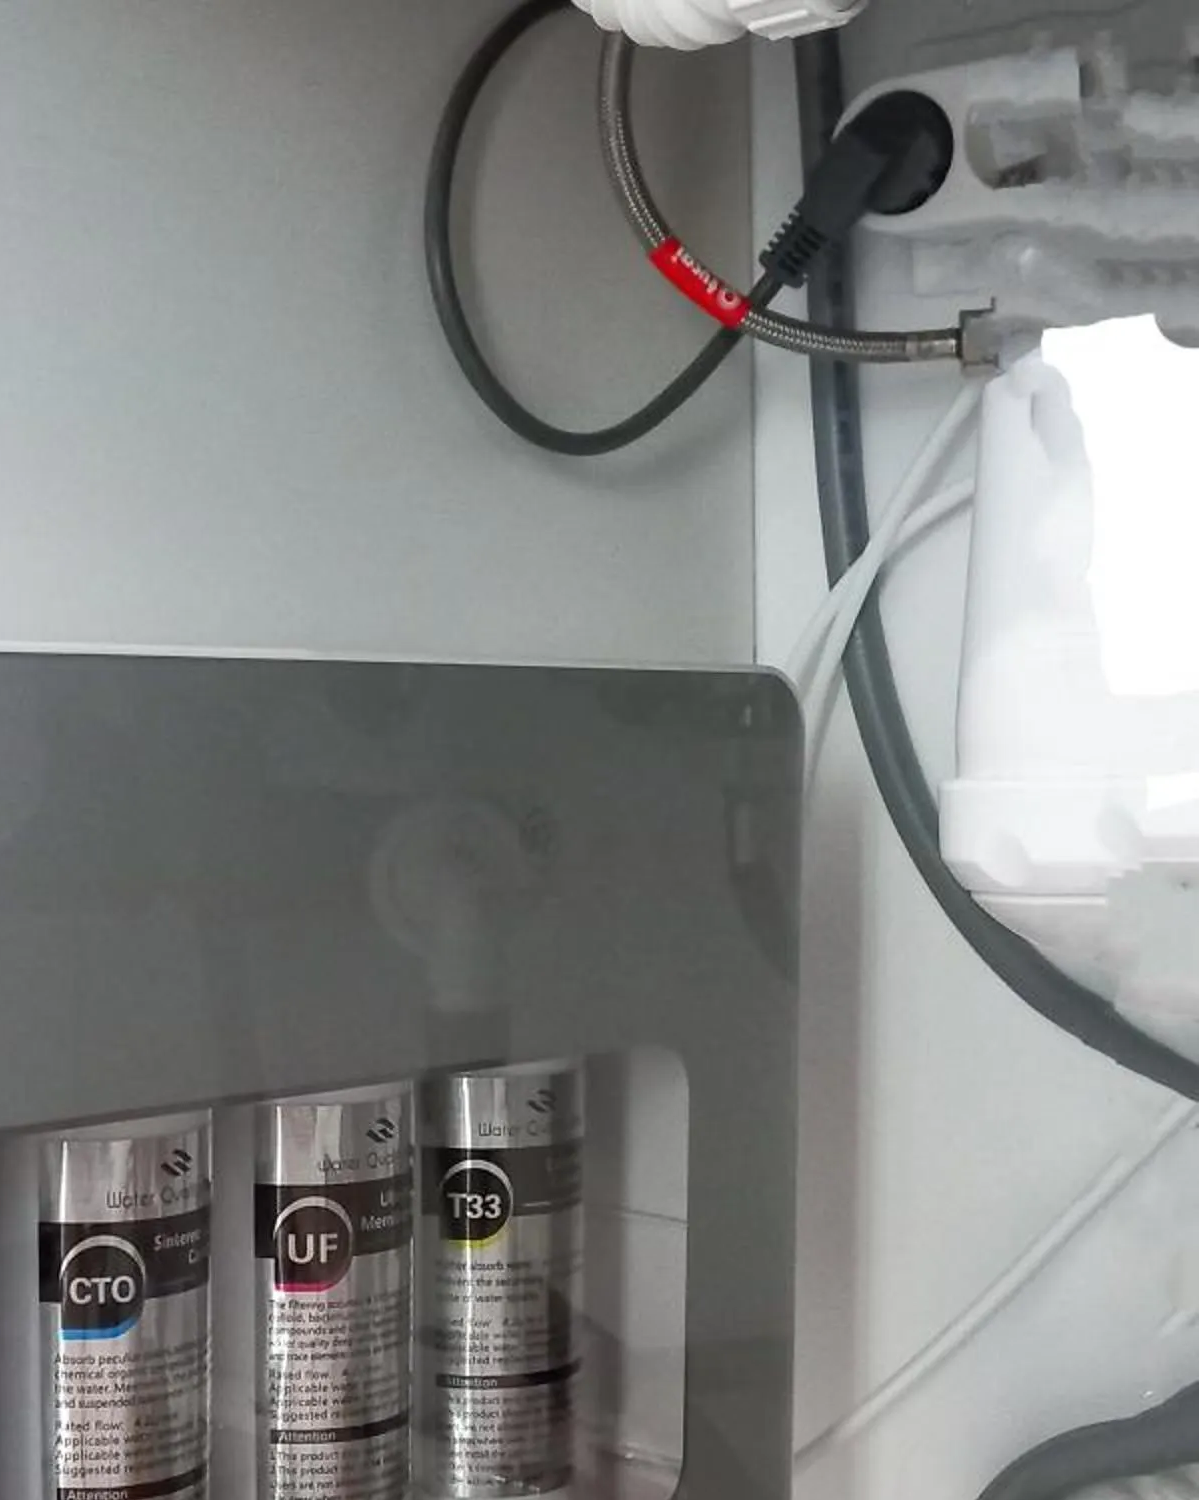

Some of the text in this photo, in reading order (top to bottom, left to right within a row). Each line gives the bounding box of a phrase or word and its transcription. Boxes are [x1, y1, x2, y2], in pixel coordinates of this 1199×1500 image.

[446, 1192, 502, 1219] T33
[287, 1233, 338, 1264] UF
[69, 1275, 135, 1304] CTO
[54, 1352, 96, 1365] Absorb
[271, 1410, 328, 1422] Sggested
[54, 1434, 120, 1448] Applicable
[54, 1463, 120, 1478] Suggested
[66, 1490, 128, 1500] Attention
